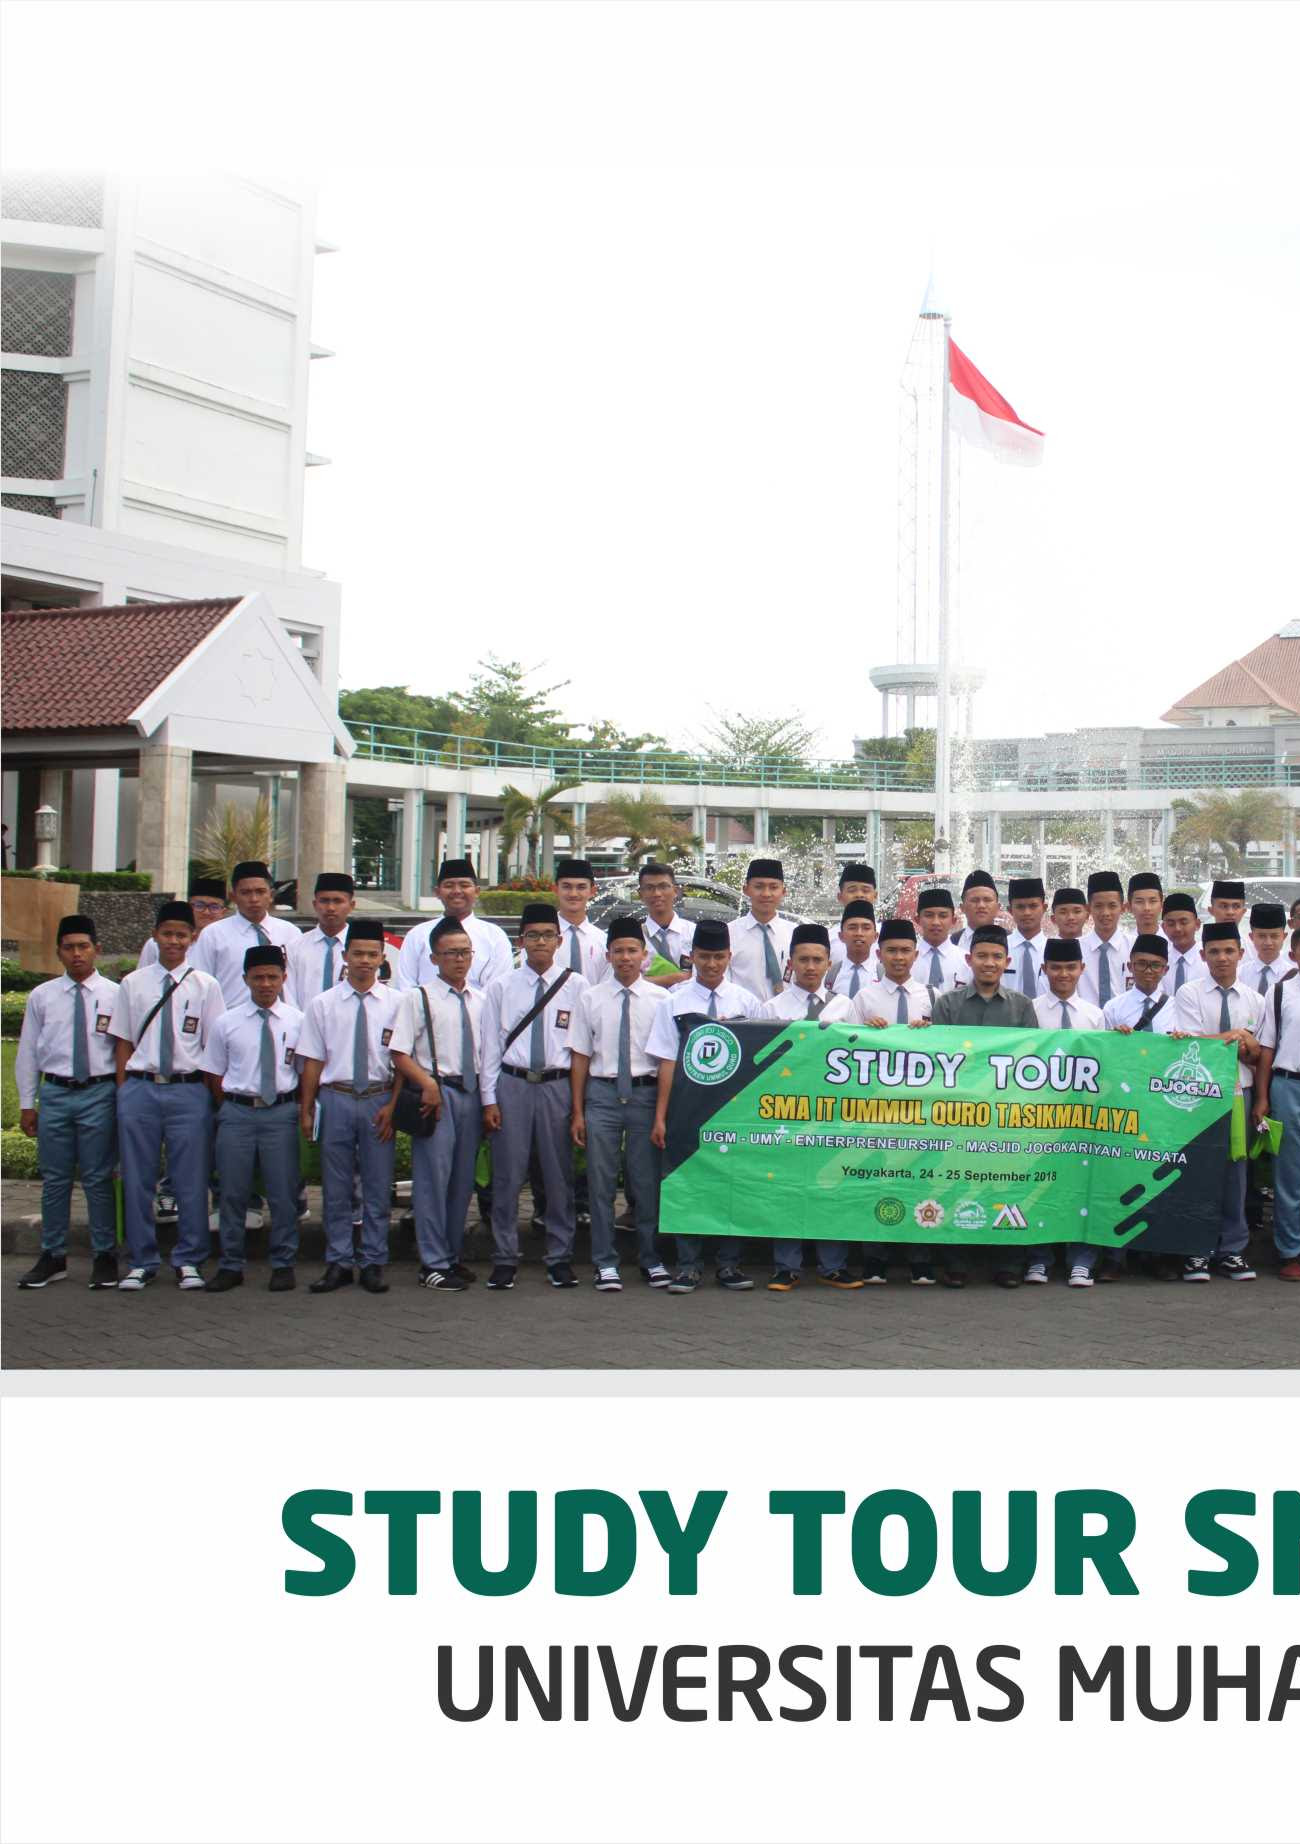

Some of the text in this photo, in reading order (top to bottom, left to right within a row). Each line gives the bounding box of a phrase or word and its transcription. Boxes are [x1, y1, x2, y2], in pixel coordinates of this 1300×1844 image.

[824, 1048, 1100, 1093] STUDY TOUR
[1149, 1077, 1223, 1099] DJOGJA
[759, 1094, 1139, 1135] SMA IT UMMUL QURO TASIKMALAYA
[703, 1131, 737, 1144] UGM
[750, 1133, 784, 1145] UMY
[795, 1135, 953, 1151] ENTERPRENEURSHIP
[966, 1140, 1021, 1153] MASJID
[1025, 1142, 1121, 1158] JOGOKARIYAN
[1134, 1149, 1188, 1165] WISATA
[842, 1166, 915, 1180] Yogyakarta,
[919, 1169, 934, 1179] 24
[946, 1170, 961, 1180] 25
[964, 1170, 1031, 1183] September
[1034, 1171, 1057, 1182] 2018
